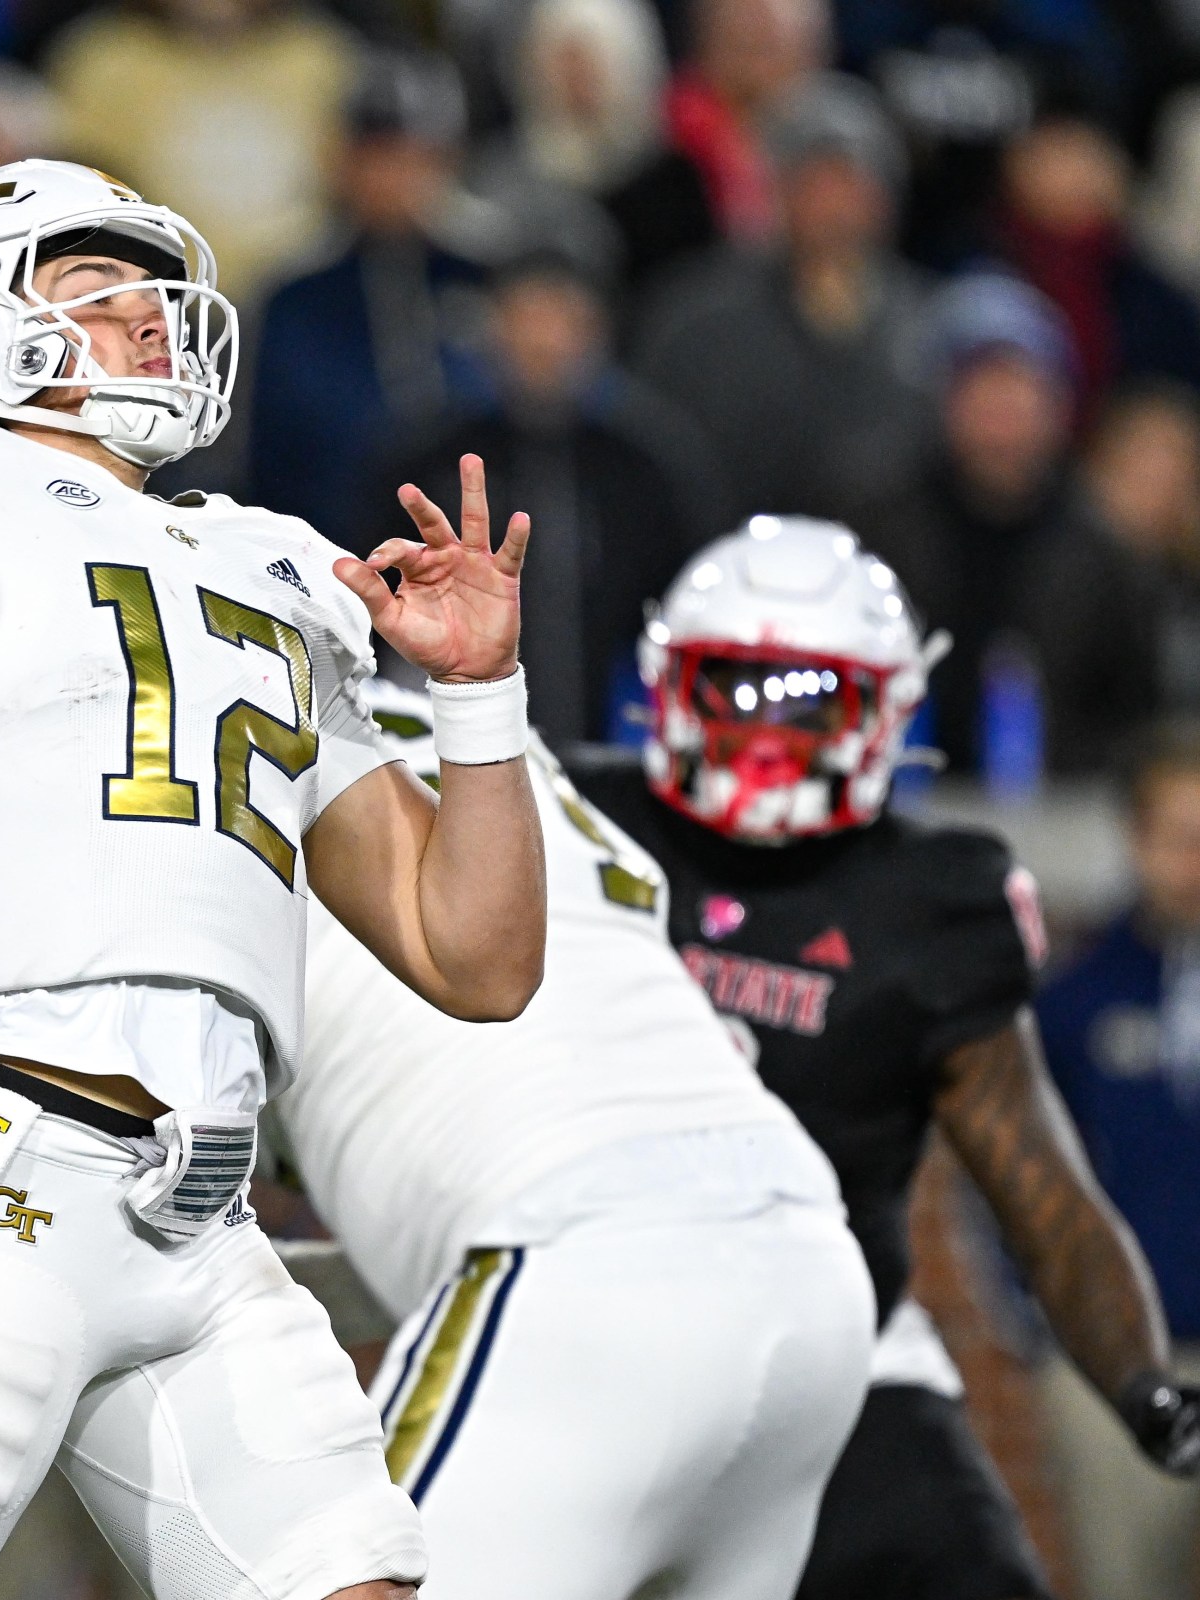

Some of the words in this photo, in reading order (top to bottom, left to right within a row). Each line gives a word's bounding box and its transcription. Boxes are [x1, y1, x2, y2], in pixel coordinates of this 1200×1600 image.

[56, 485, 92, 500] ACC
[266, 565, 311, 598] adidas
[85, 562, 319, 893] 12
